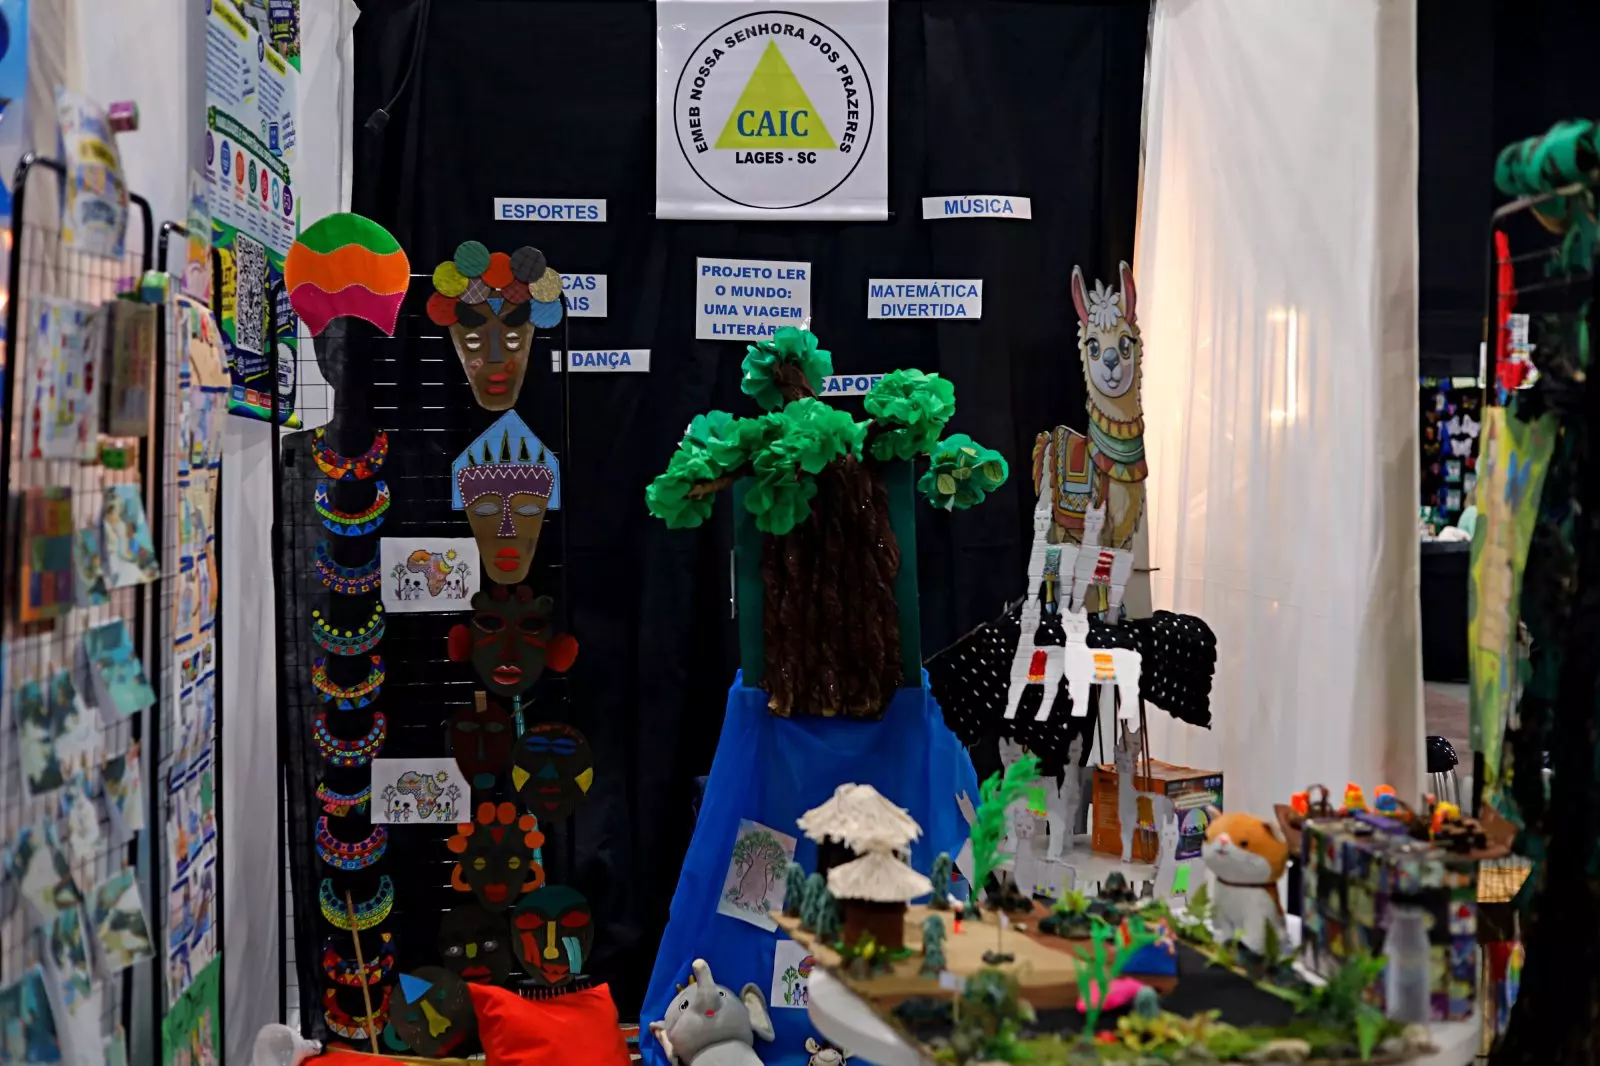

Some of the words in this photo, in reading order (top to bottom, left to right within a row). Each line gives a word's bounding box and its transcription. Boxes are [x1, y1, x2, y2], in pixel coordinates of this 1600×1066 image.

[724, 22, 805, 49] SENHORA
[809, 34, 840, 63] DOS
[690, 48, 725, 101] NOSSA
[836, 64, 859, 154] PRAZERES
[689, 106, 709, 154] EMEB
[737, 110, 809, 137] CAIC
[735, 151, 784, 164] LAGES
[797, 151, 817, 164] SC
[502, 204, 599, 219] ESPORTES
[944, 198, 1014, 215] MÚSICA
[701, 265, 773, 279] PROJETO
[777, 268, 806, 280] LER
[561, 275, 597, 290] CAS
[870, 282, 978, 298] MATEMÁTICA
[715, 285, 726, 297] O
[731, 286, 792, 299] MUNDO:
[704, 303, 738, 316] UMA
[742, 305, 803, 318] VIAGEM
[881, 304, 967, 317] DIVERTIDA
[712, 323, 780, 336] LITERÁR
[571, 352, 631, 369] DANÇA
